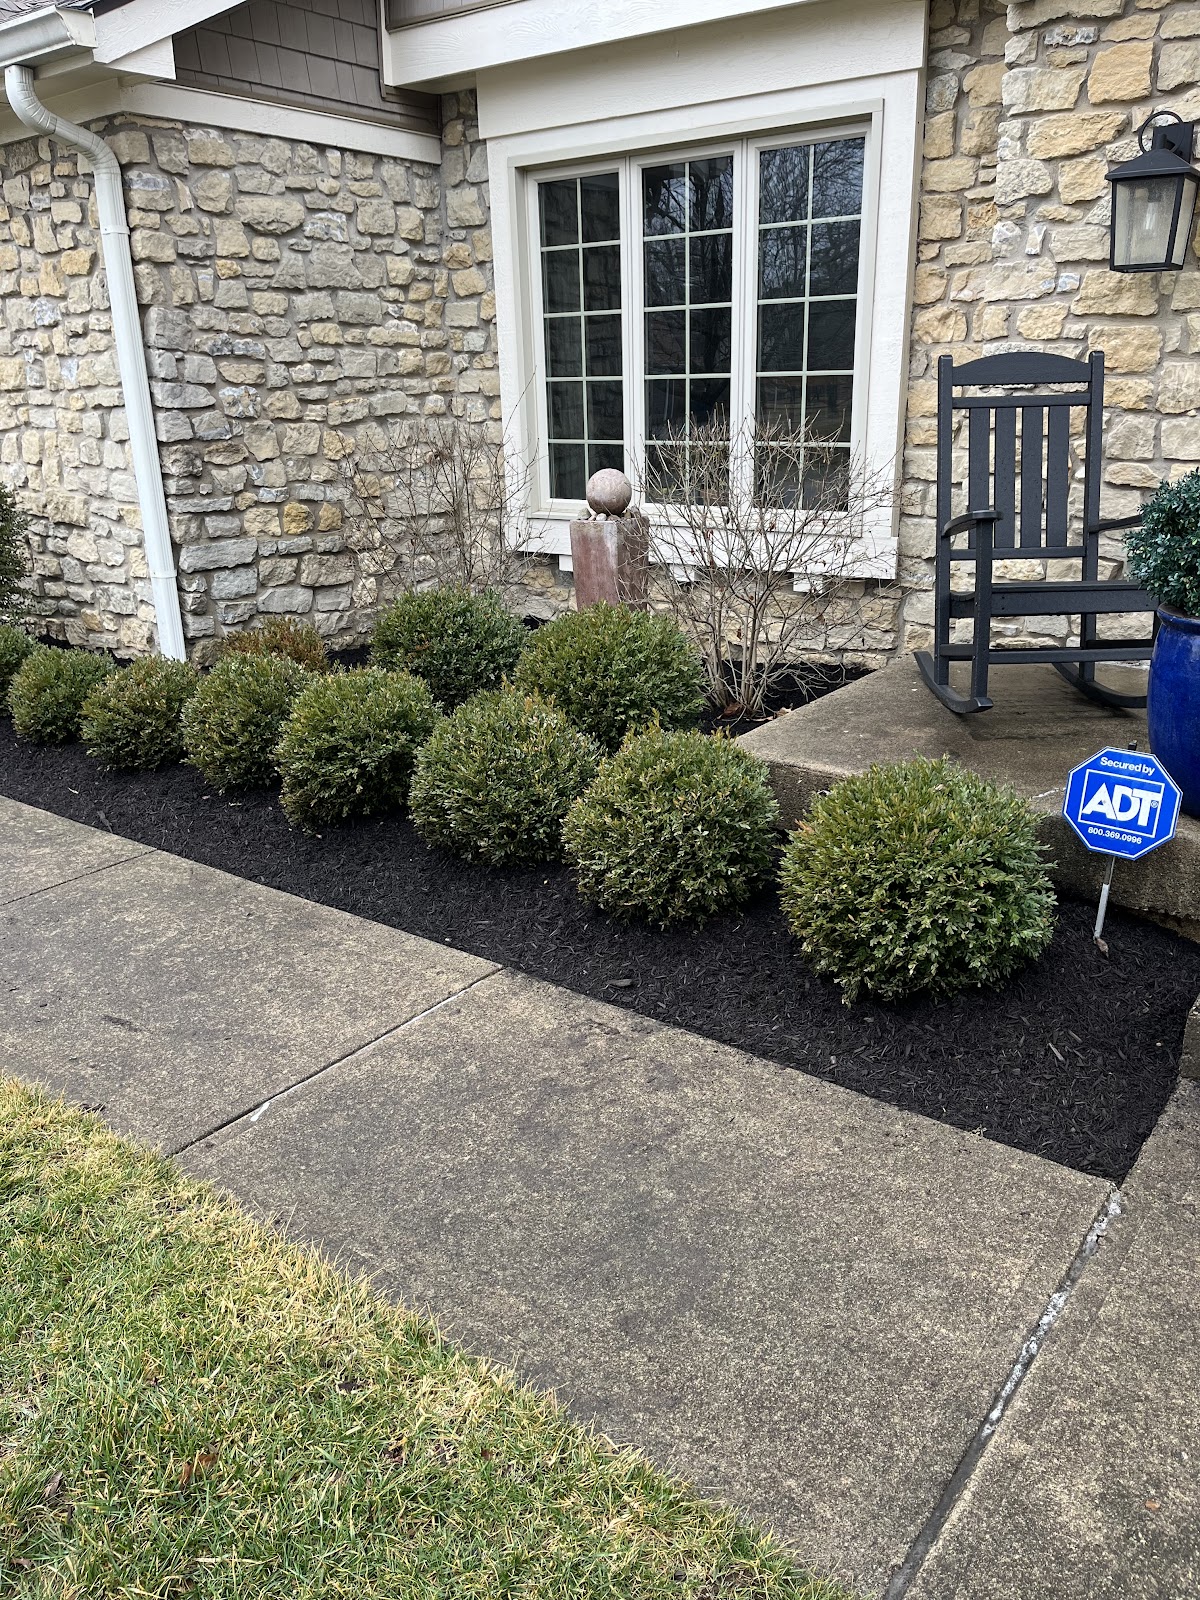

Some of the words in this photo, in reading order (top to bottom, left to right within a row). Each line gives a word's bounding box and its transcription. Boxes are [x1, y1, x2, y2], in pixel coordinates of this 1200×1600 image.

[1100, 757, 1142, 772] Secured
[1142, 764, 1155, 776] by
[1082, 782, 1162, 827] ADT
[1087, 827, 1142, 845] 800.369.0996
